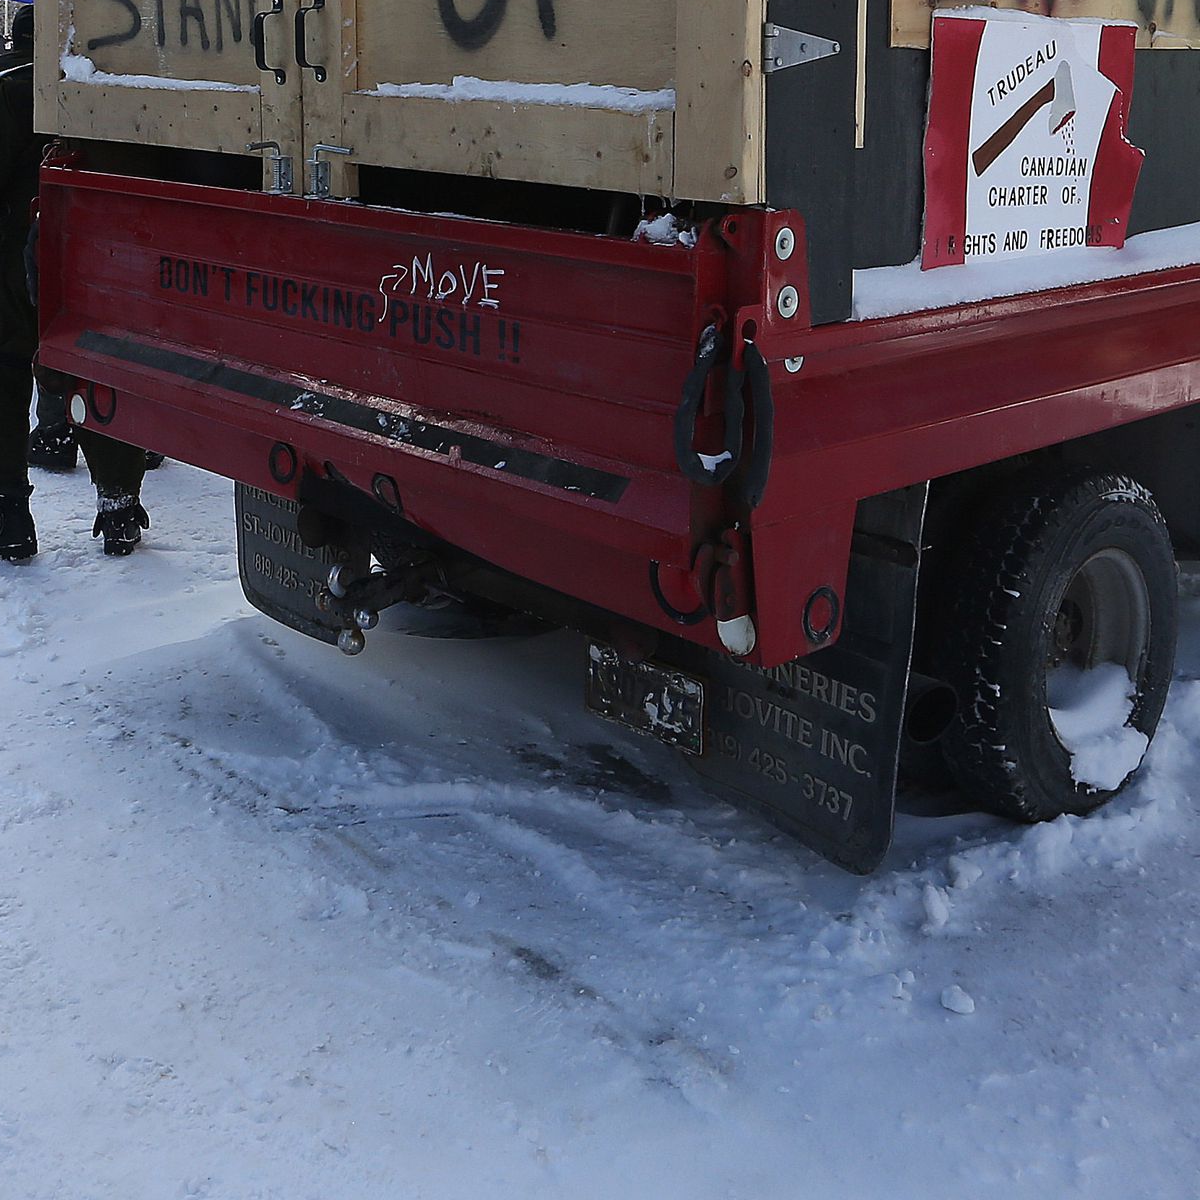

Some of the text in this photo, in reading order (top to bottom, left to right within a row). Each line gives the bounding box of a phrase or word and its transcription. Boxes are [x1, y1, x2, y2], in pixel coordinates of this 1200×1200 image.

[986, 39, 1058, 107] TRUDEAU
[1021, 156, 1088, 178] CANADIAN
[988, 185, 1049, 207] CHARTER
[1003, 230, 1028, 251] AND
[159, 255, 236, 303] DON'T
[245, 271, 376, 333] FUCKING
[388, 299, 483, 357] PUSH
[819, 727, 873, 779] INC.
